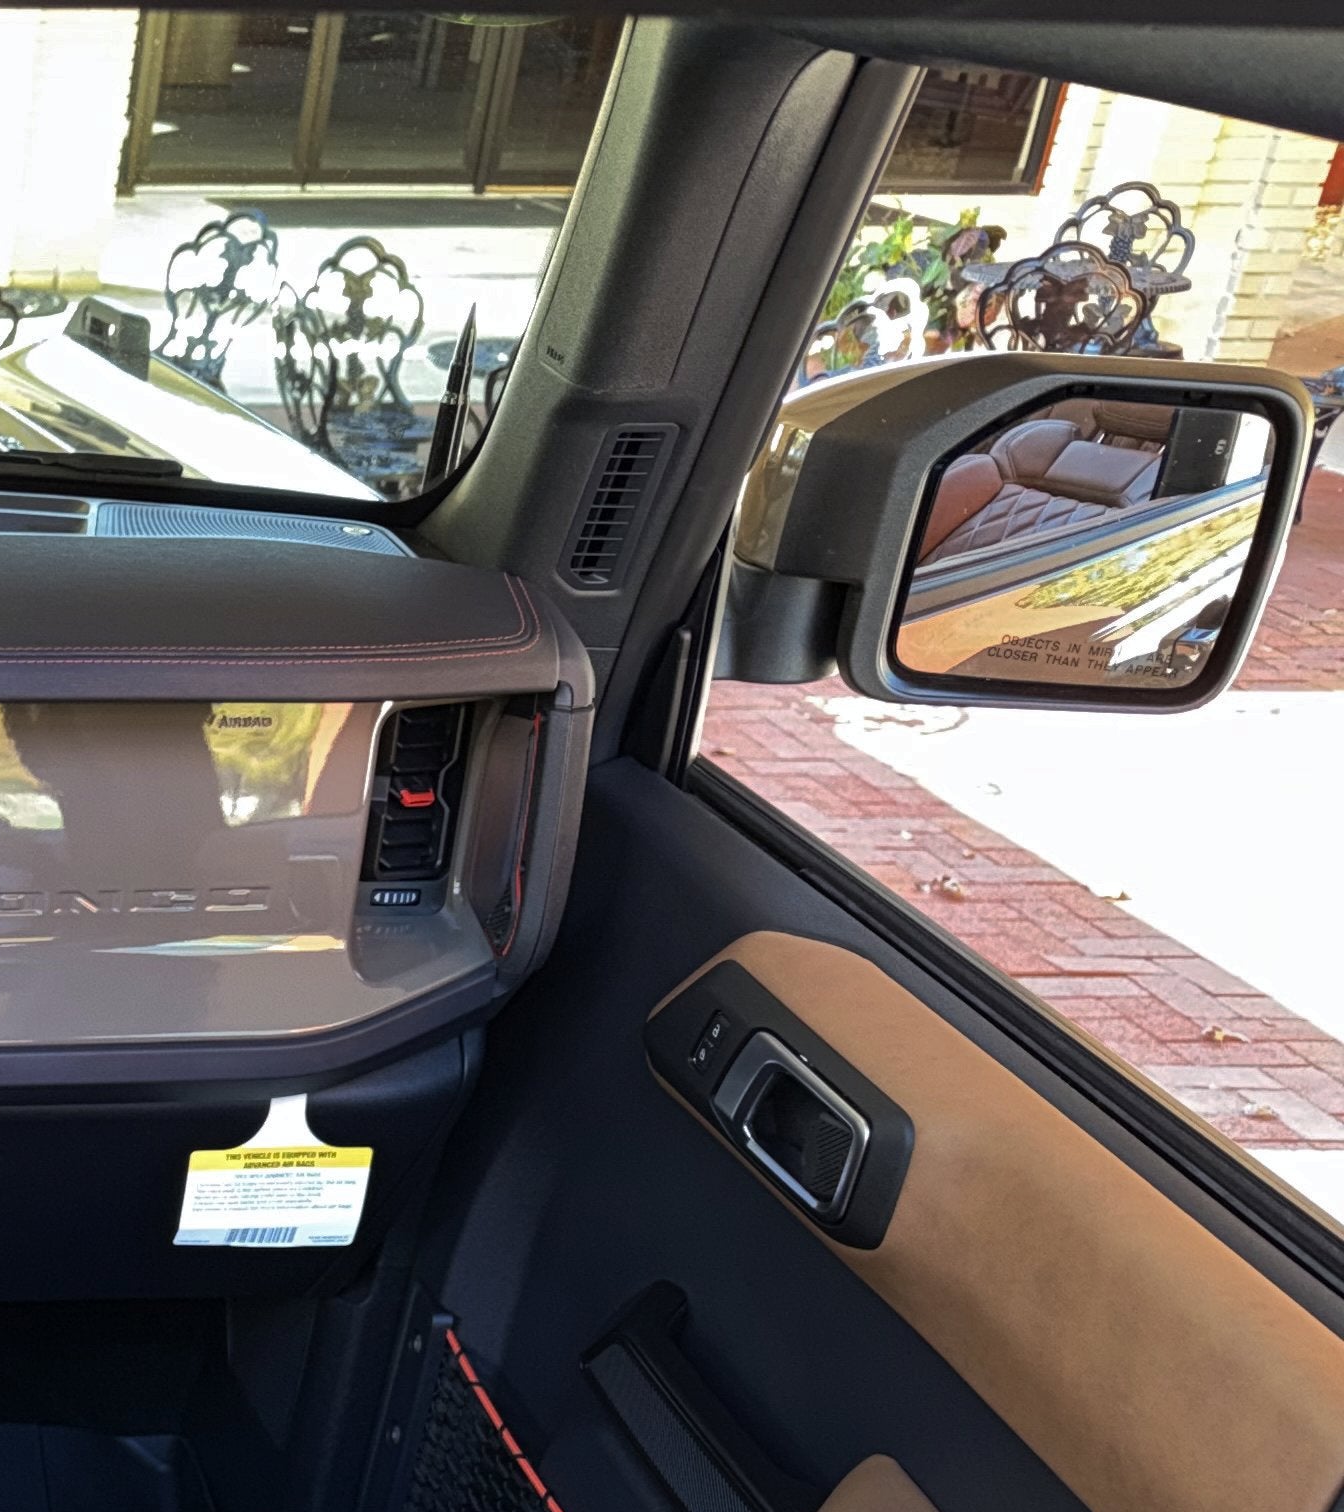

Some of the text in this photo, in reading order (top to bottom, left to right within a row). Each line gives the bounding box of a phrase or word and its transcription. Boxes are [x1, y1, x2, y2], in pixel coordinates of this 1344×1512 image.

[1001, 634, 1061, 651] OBJECTS
[1068, 643, 1083, 654] IN
[987, 646, 1179, 679] CLOSER THAN THEY APPEAR
